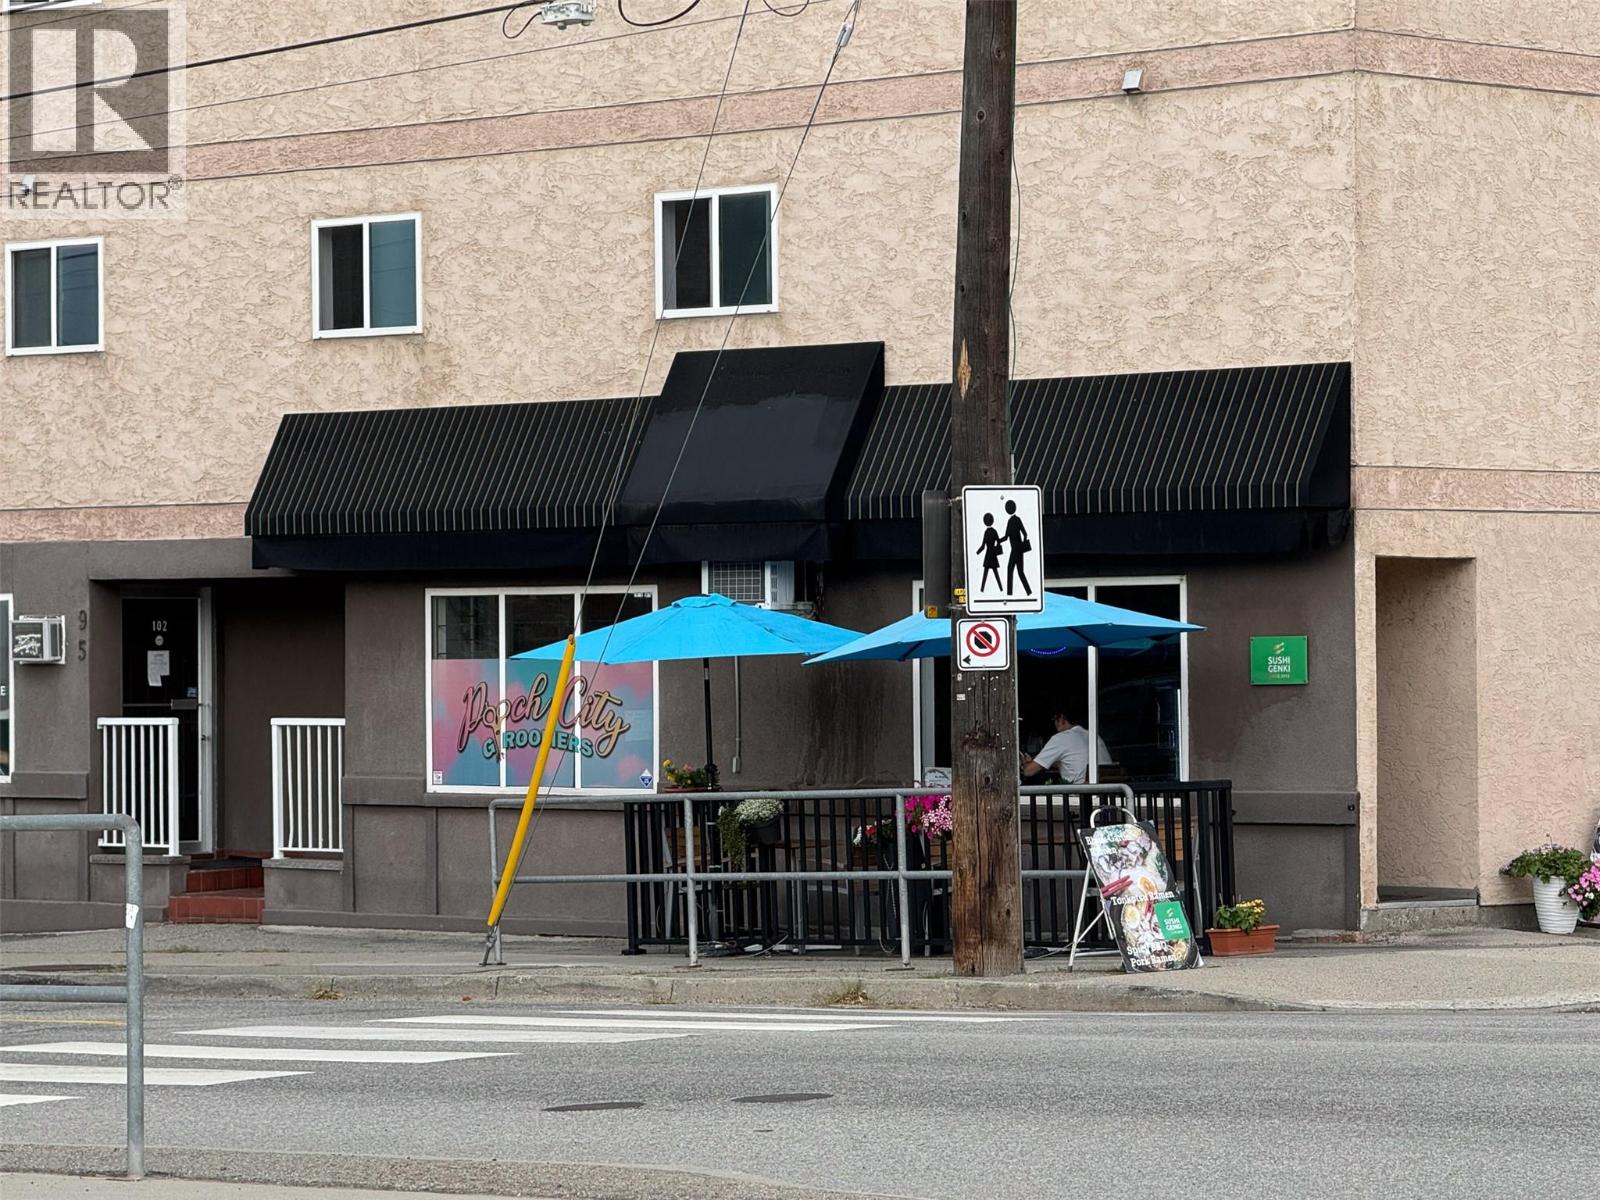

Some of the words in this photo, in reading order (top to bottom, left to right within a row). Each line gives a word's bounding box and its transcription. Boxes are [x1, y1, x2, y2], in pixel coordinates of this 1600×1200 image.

[152, 620, 168, 632] 102
[1267, 656, 1291, 665] SUSHI
[1267, 664, 1291, 673] GENKI
[457, 672, 553, 753] Pooch
[557, 675, 631, 759] City
[1130, 956, 1150, 967] Pork
